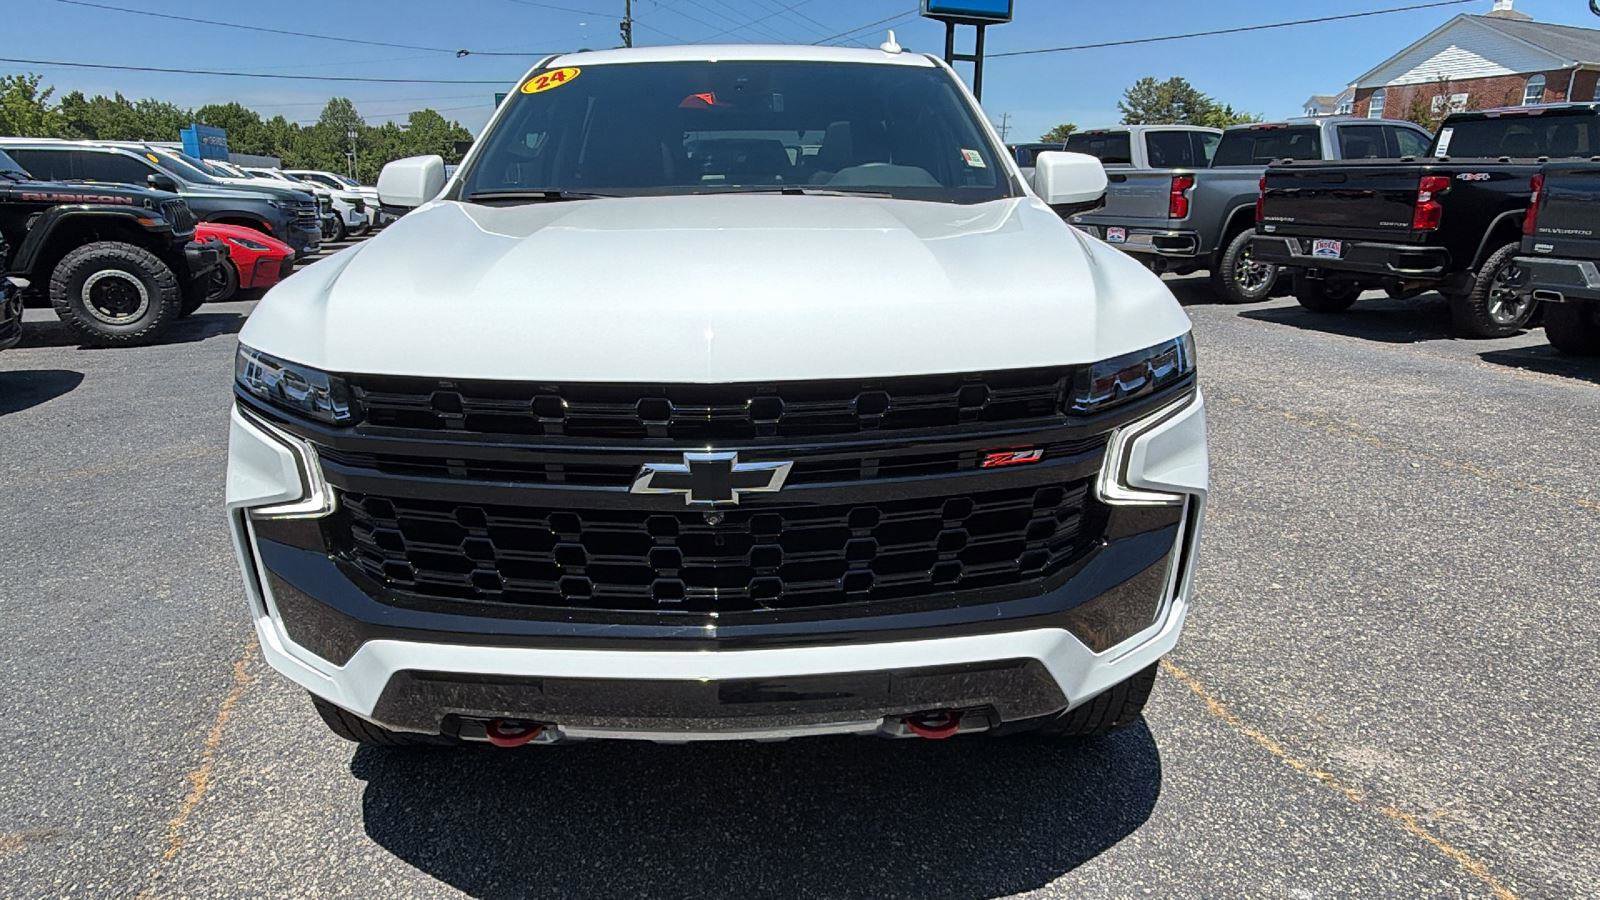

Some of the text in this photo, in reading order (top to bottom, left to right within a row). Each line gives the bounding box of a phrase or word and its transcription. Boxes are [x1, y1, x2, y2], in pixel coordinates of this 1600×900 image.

[535, 70, 566, 90] 24
[21, 192, 133, 204] RUBICON
[1538, 227, 1593, 235] SILVERADO
[981, 449, 1044, 468] Z71
